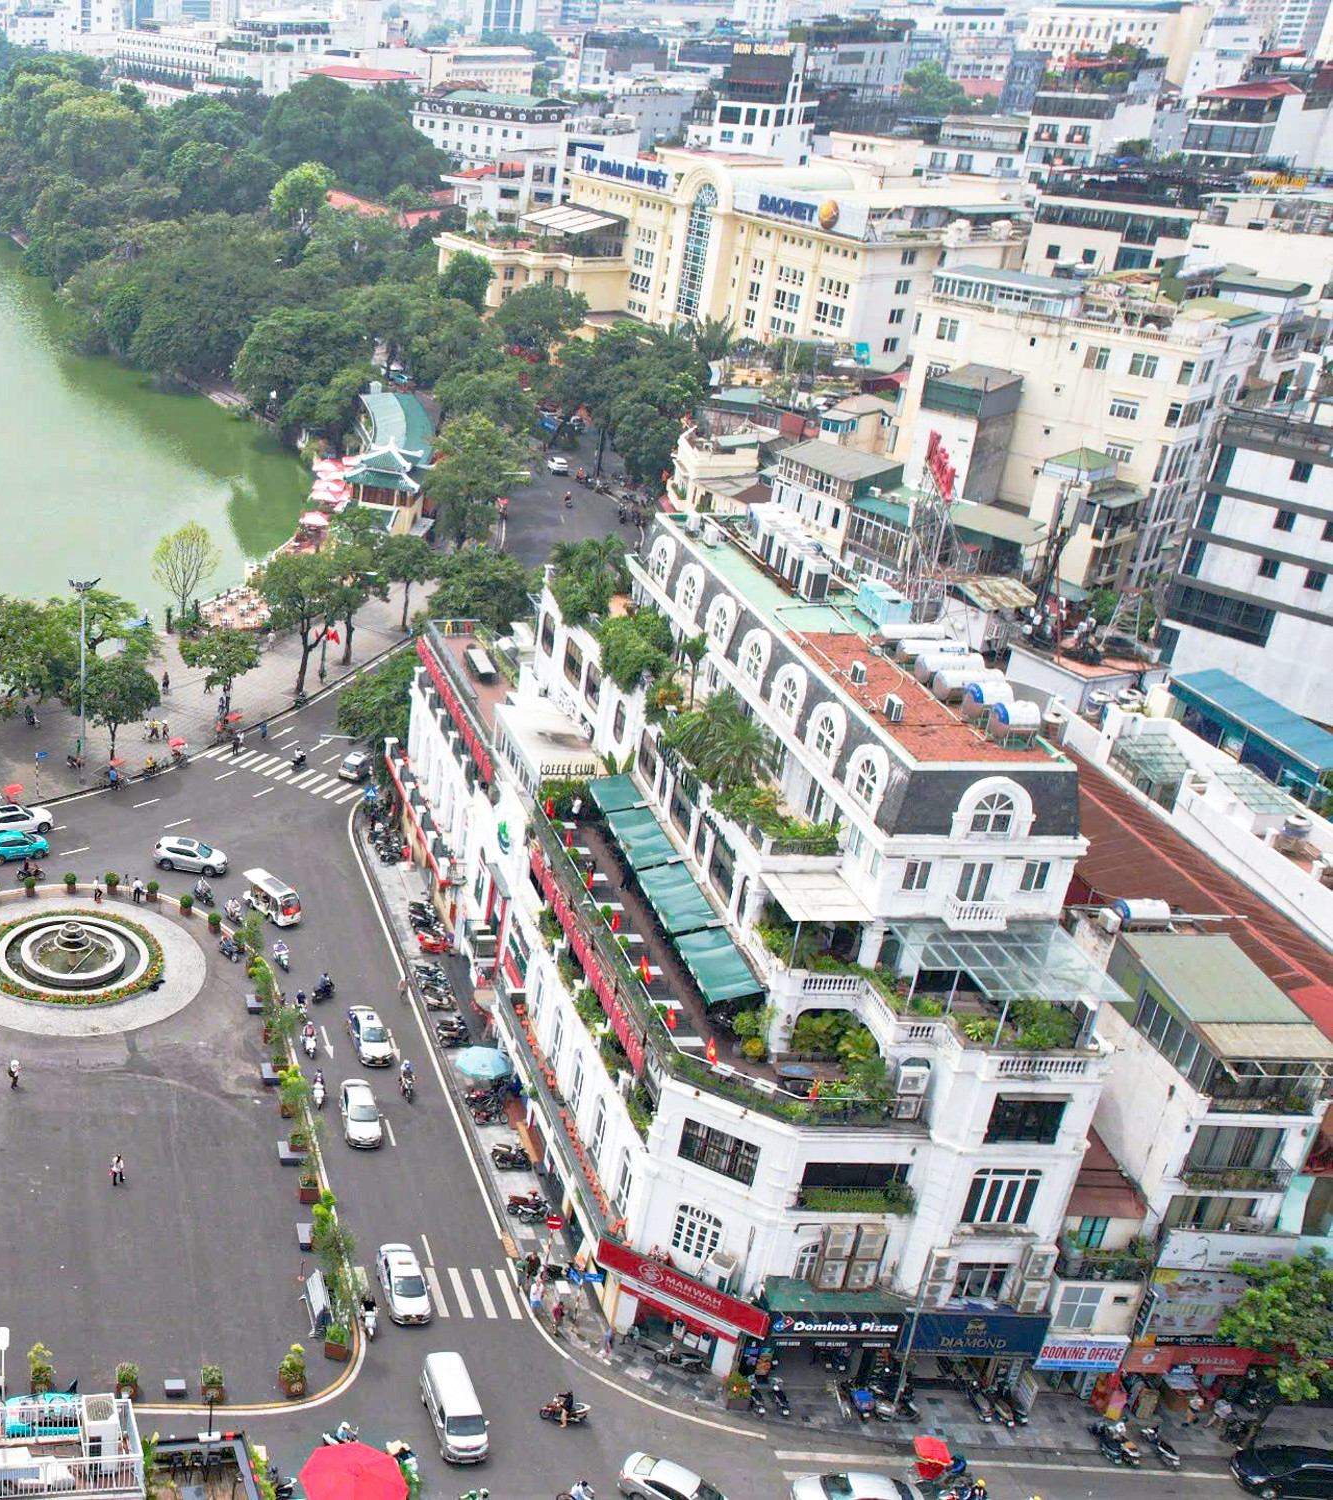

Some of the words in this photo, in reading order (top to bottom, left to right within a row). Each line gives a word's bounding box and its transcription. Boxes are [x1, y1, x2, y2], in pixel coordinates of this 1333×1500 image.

[758, 194, 818, 222] BAOVIET
[540, 764, 571, 775] COFFEE
[575, 764, 595, 775] CLUB
[666, 1275, 723, 1307] MANWAH
[793, 1321, 857, 1332] Domino's
[860, 1322, 898, 1332] Pizza
[940, 1336, 1007, 1349] DIAMOND
[1041, 1346, 1086, 1360] BOOKING
[1088, 1348, 1124, 1361] OFFICE
